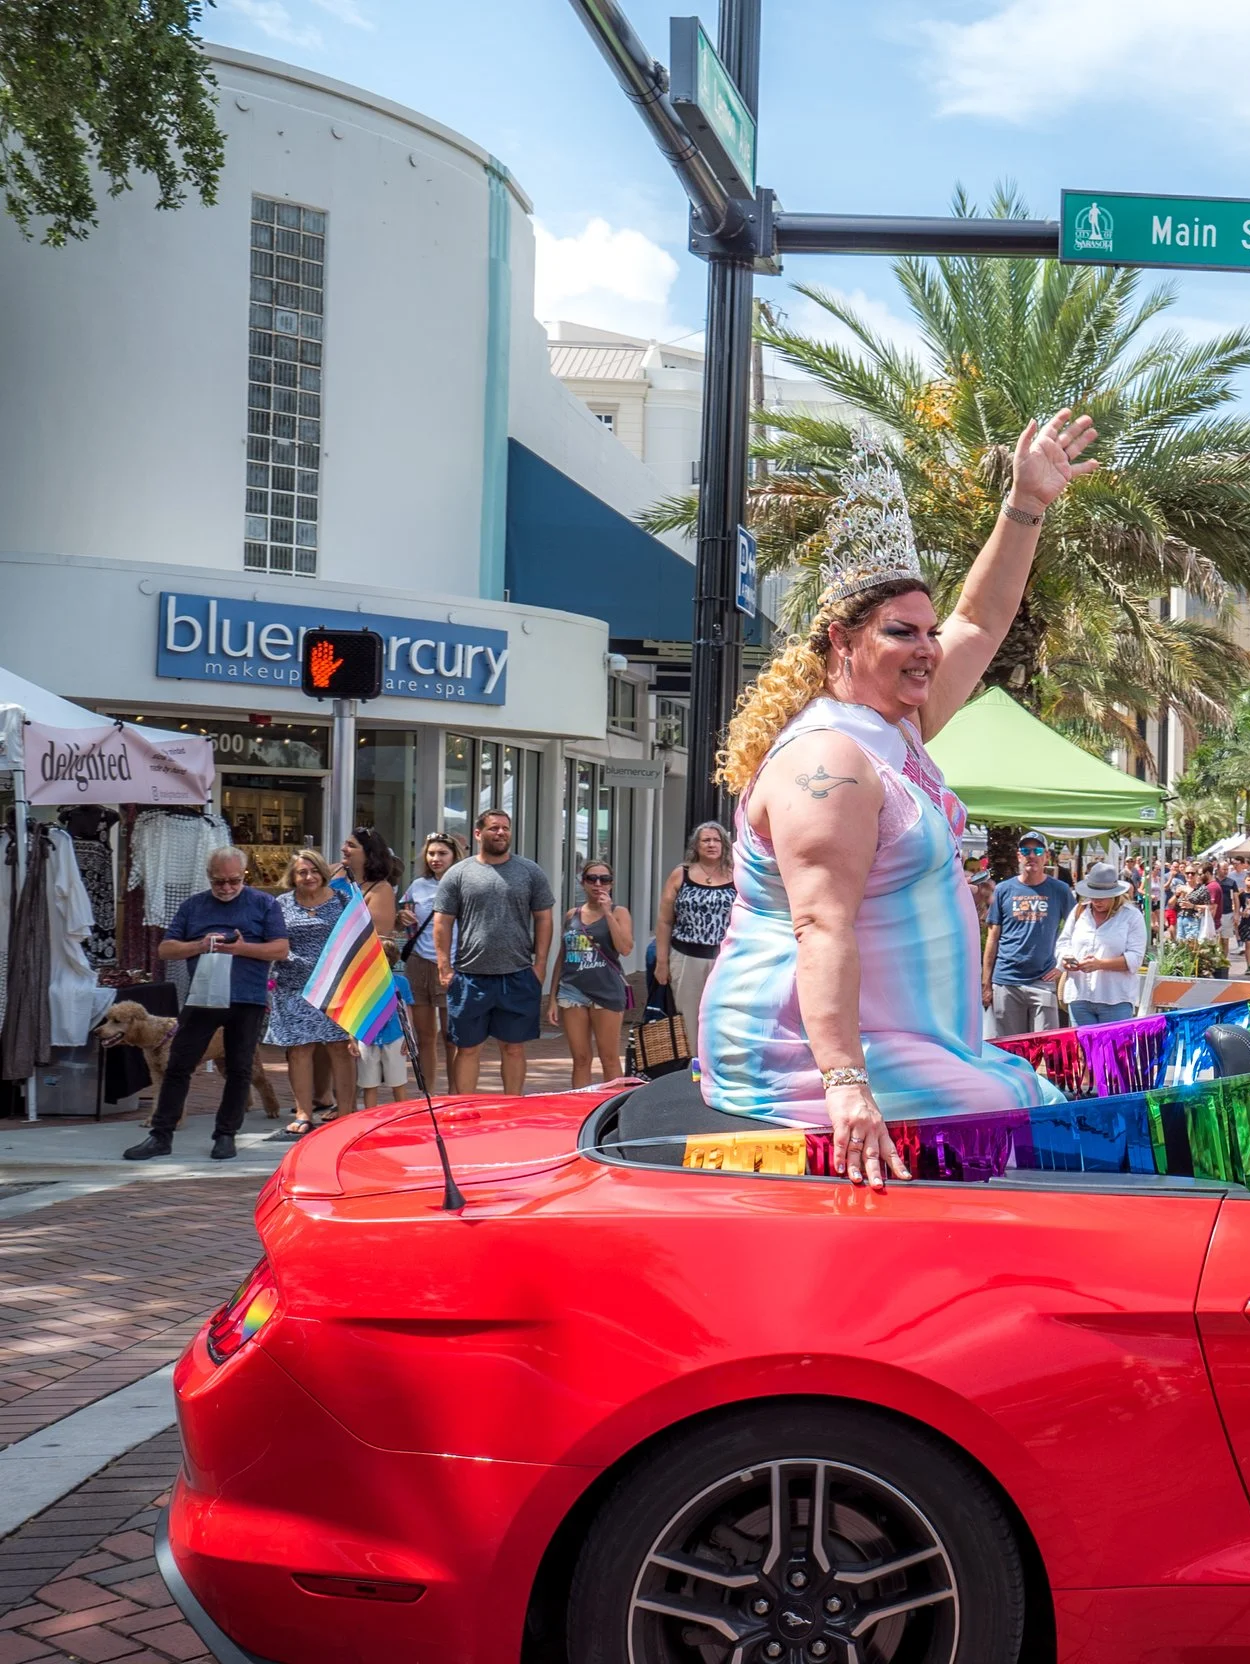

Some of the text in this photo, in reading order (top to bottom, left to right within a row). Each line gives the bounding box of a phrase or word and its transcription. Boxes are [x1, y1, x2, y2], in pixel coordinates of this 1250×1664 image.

[1151, 215, 1217, 248] Main
[165, 595, 509, 695] bluercury
[205, 659, 300, 685] makeup
[435, 681, 466, 697] spa
[40, 741, 132, 792] delighted
[606, 765, 661, 779] bluemercury
